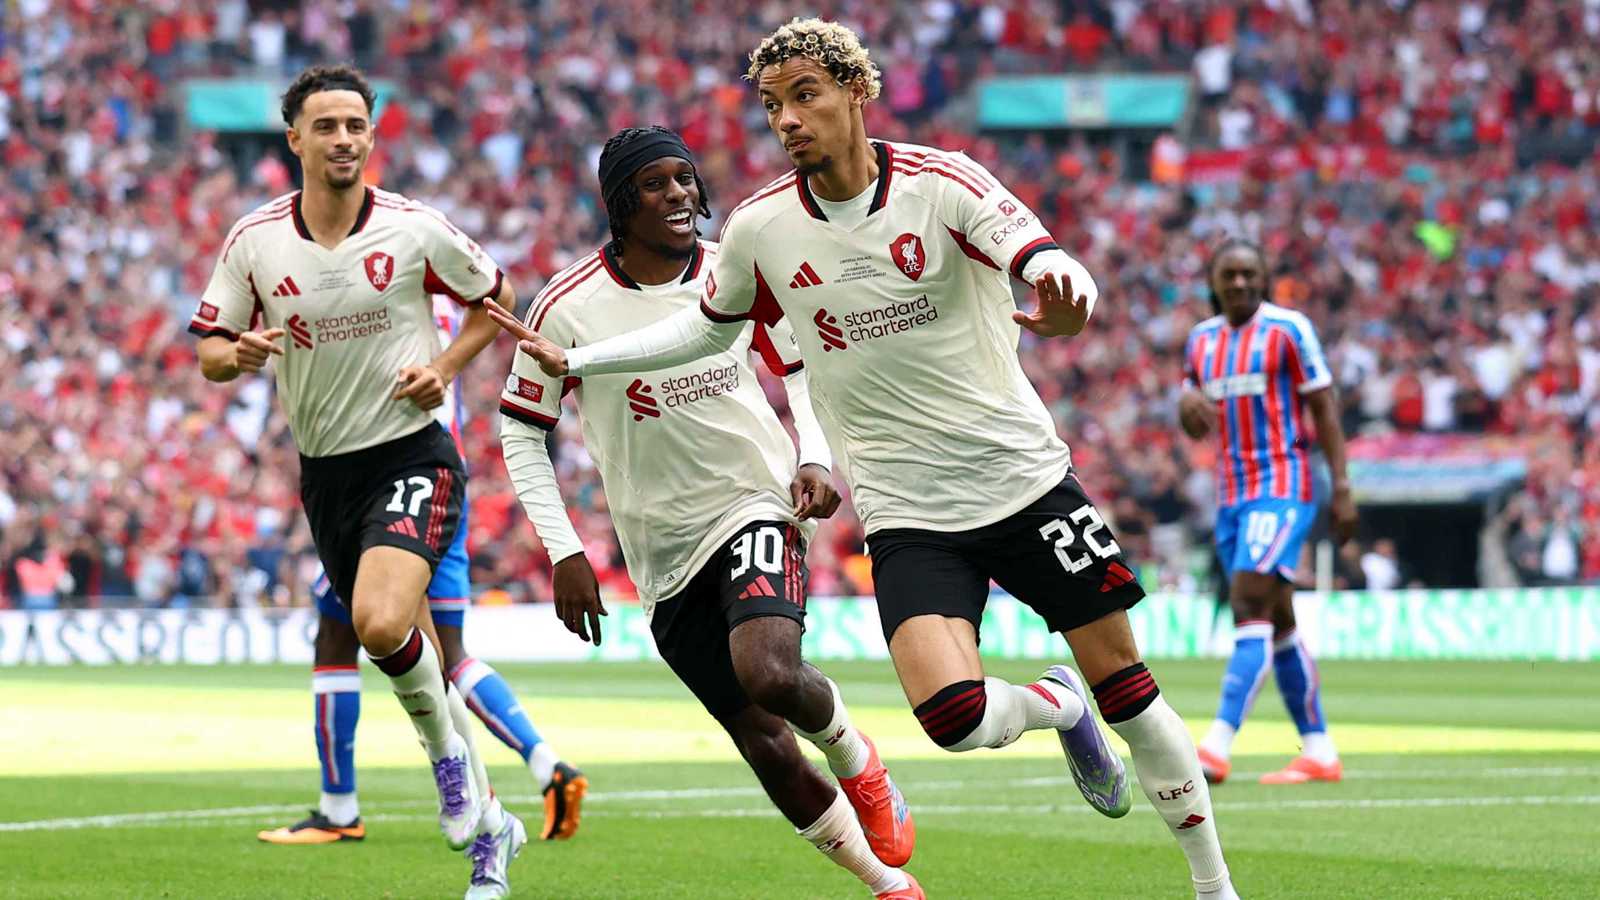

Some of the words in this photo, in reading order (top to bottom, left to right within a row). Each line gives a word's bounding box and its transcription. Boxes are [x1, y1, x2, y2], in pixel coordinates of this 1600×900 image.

[991, 212, 1035, 245] Expe
[904, 262, 922, 274] LFC
[315, 304, 388, 330] standard
[844, 294, 929, 327] standard
[849, 306, 938, 342] chartered
[318, 320, 392, 343] chartered
[661, 361, 738, 394] standard
[665, 374, 739, 408] chartered
[385, 476, 434, 517] 17
[1038, 503, 1121, 574] 22
[1246, 510, 1279, 545] 10
[730, 526, 784, 582] 30
[1157, 779, 1195, 801] LFC
